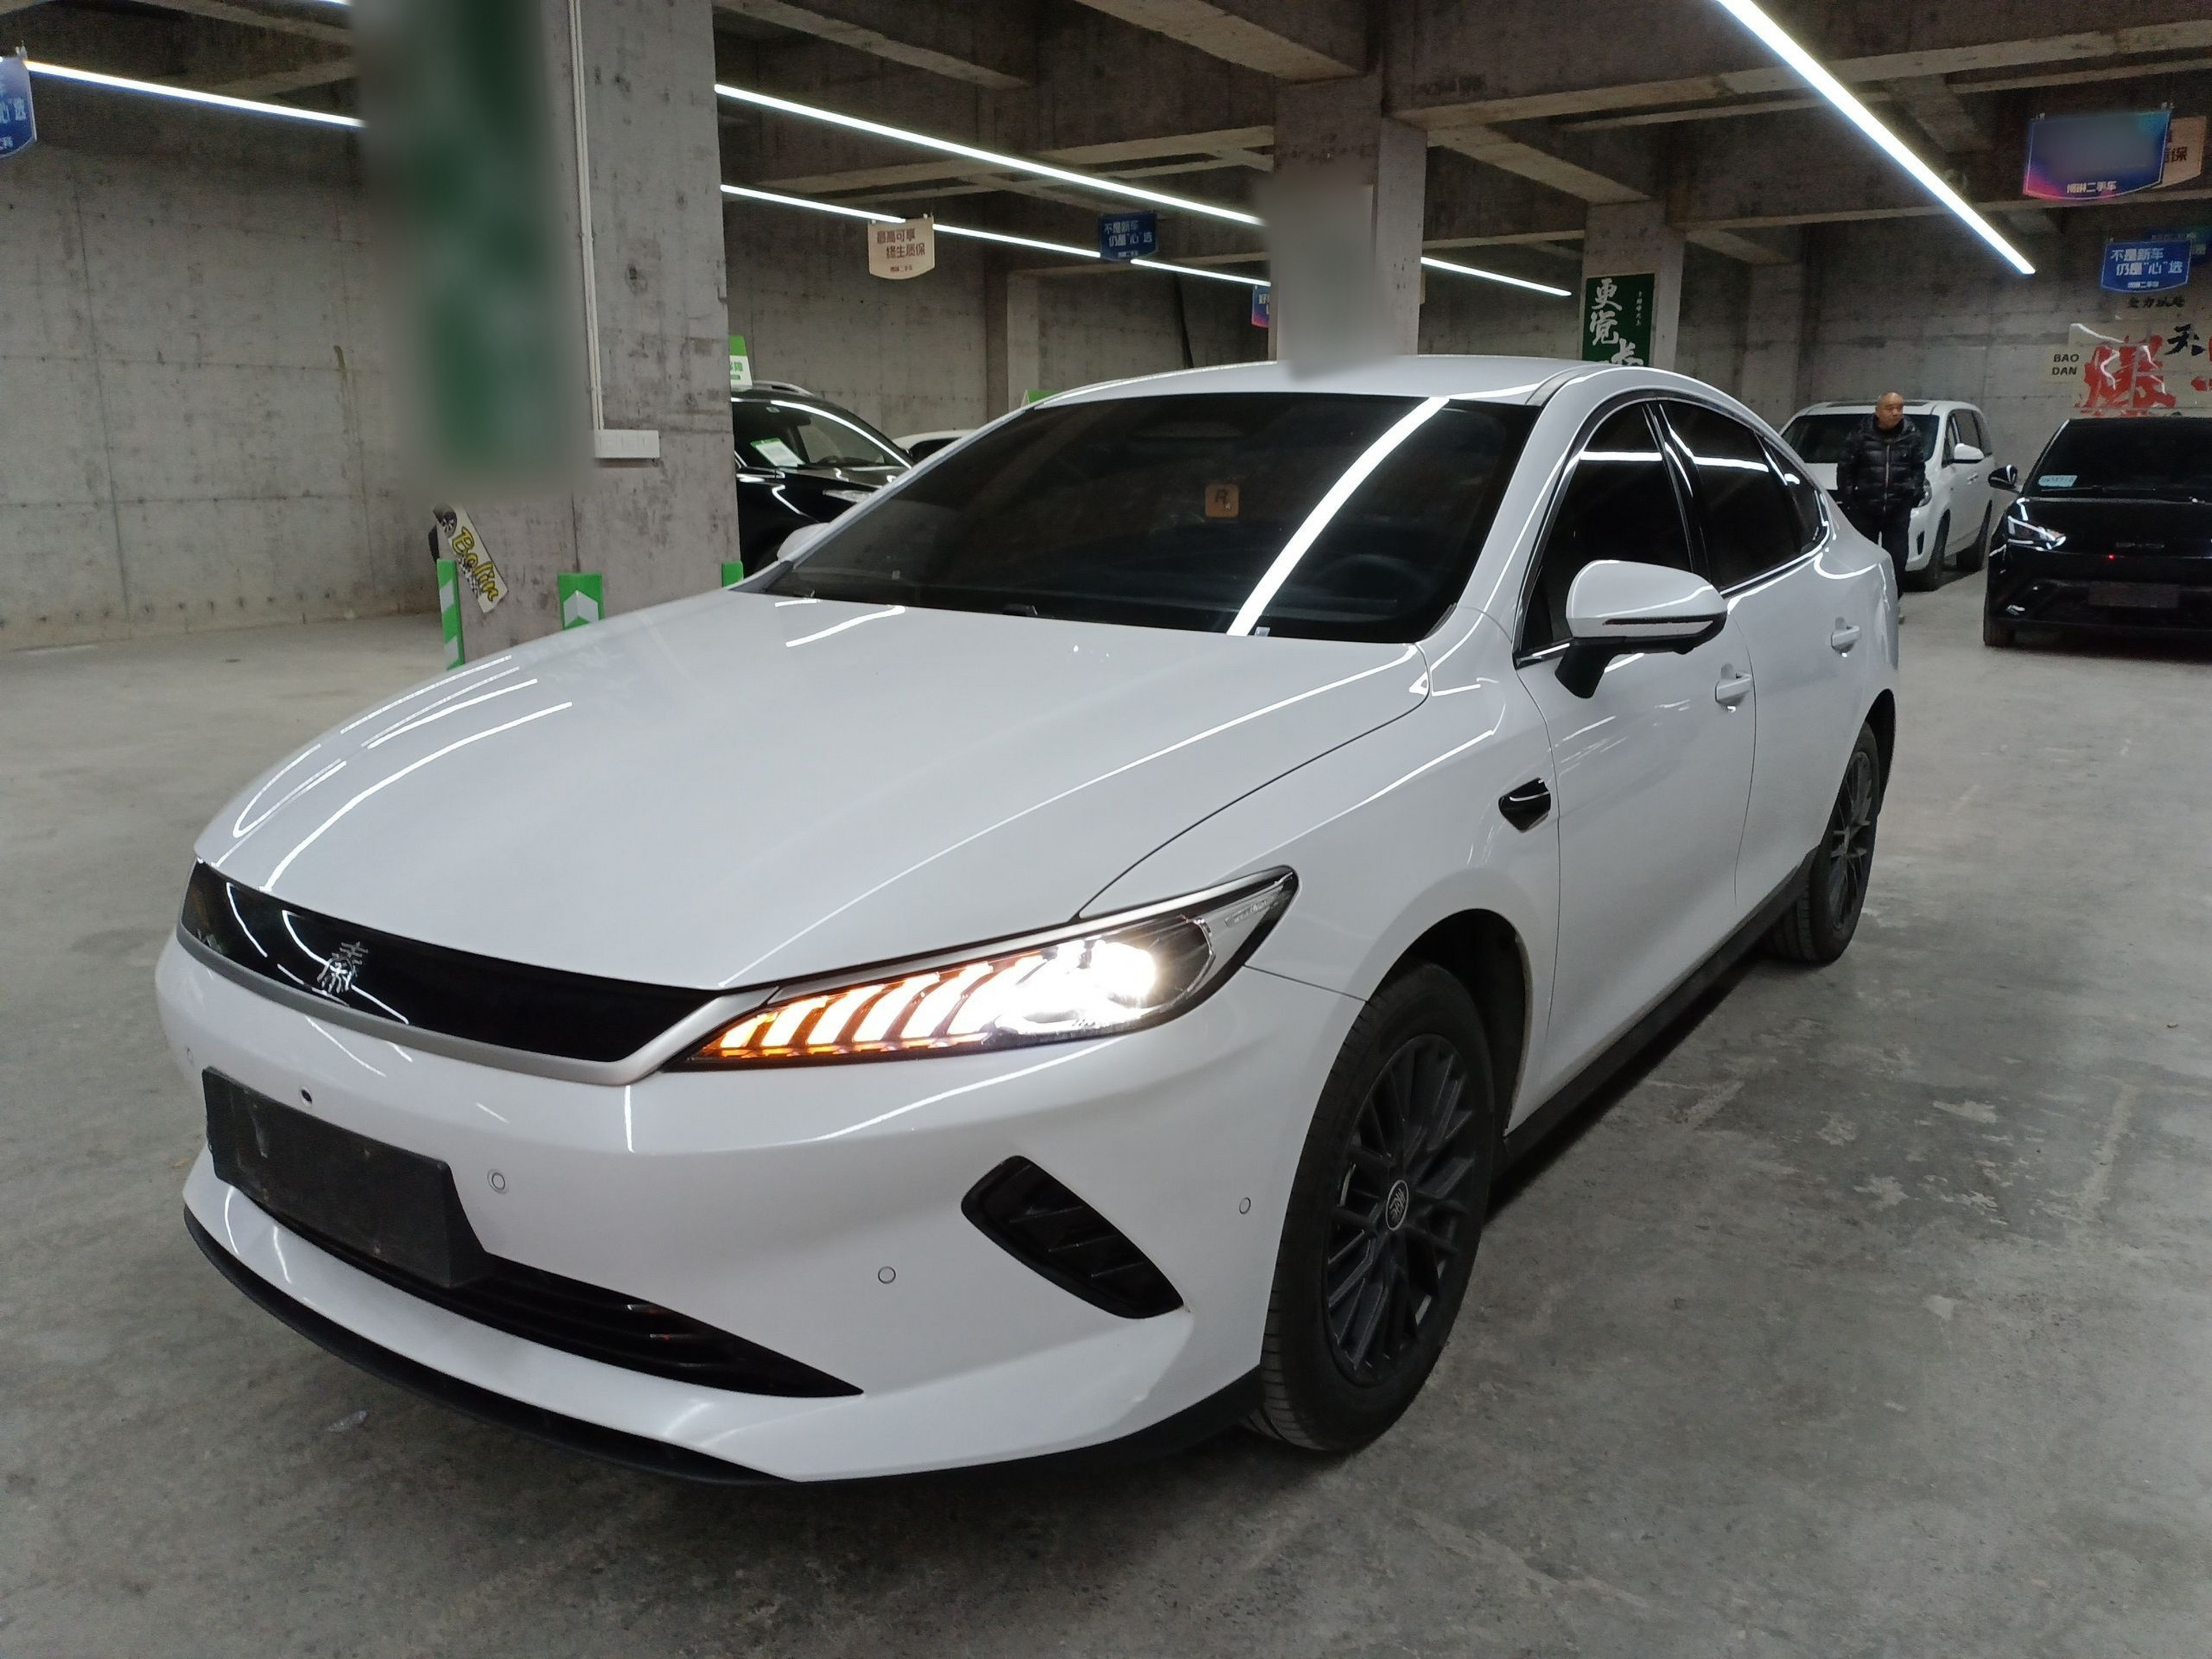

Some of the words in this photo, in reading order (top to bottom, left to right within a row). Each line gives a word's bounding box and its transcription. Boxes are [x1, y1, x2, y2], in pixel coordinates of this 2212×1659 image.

[2111, 248, 2164, 262] 不是新车
[2053, 353, 2080, 363] BAO
[2051, 366, 2077, 376] DAN
